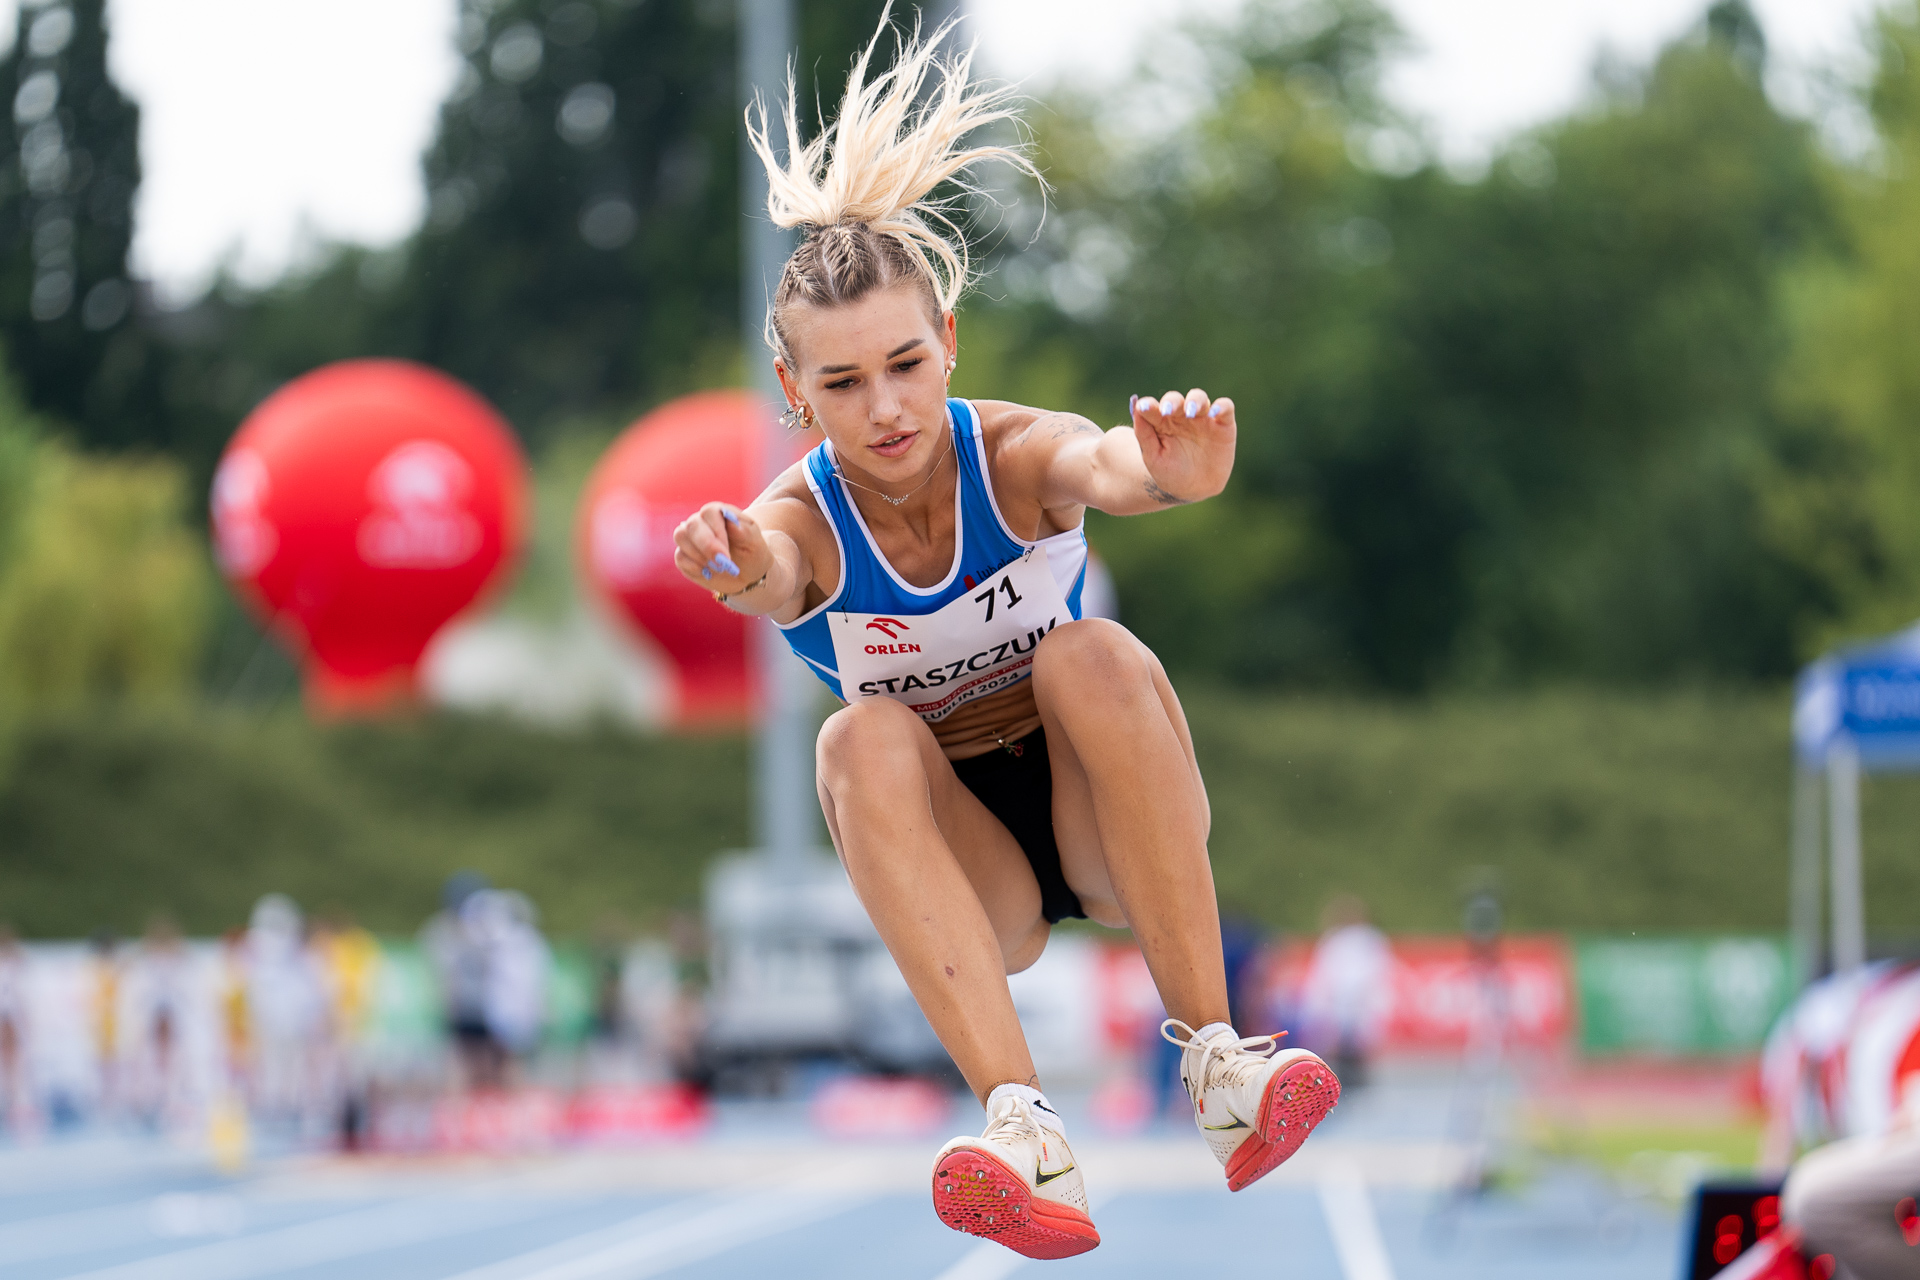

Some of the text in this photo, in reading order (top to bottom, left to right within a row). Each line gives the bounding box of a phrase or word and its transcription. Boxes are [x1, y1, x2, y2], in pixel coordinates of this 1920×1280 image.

[974, 575, 1023, 623] 71
[864, 643, 921, 655] ORLEN
[916, 657, 1034, 712] MISTRZOSTWA POLS
[921, 672, 1019, 720] LUBLIN 2024
